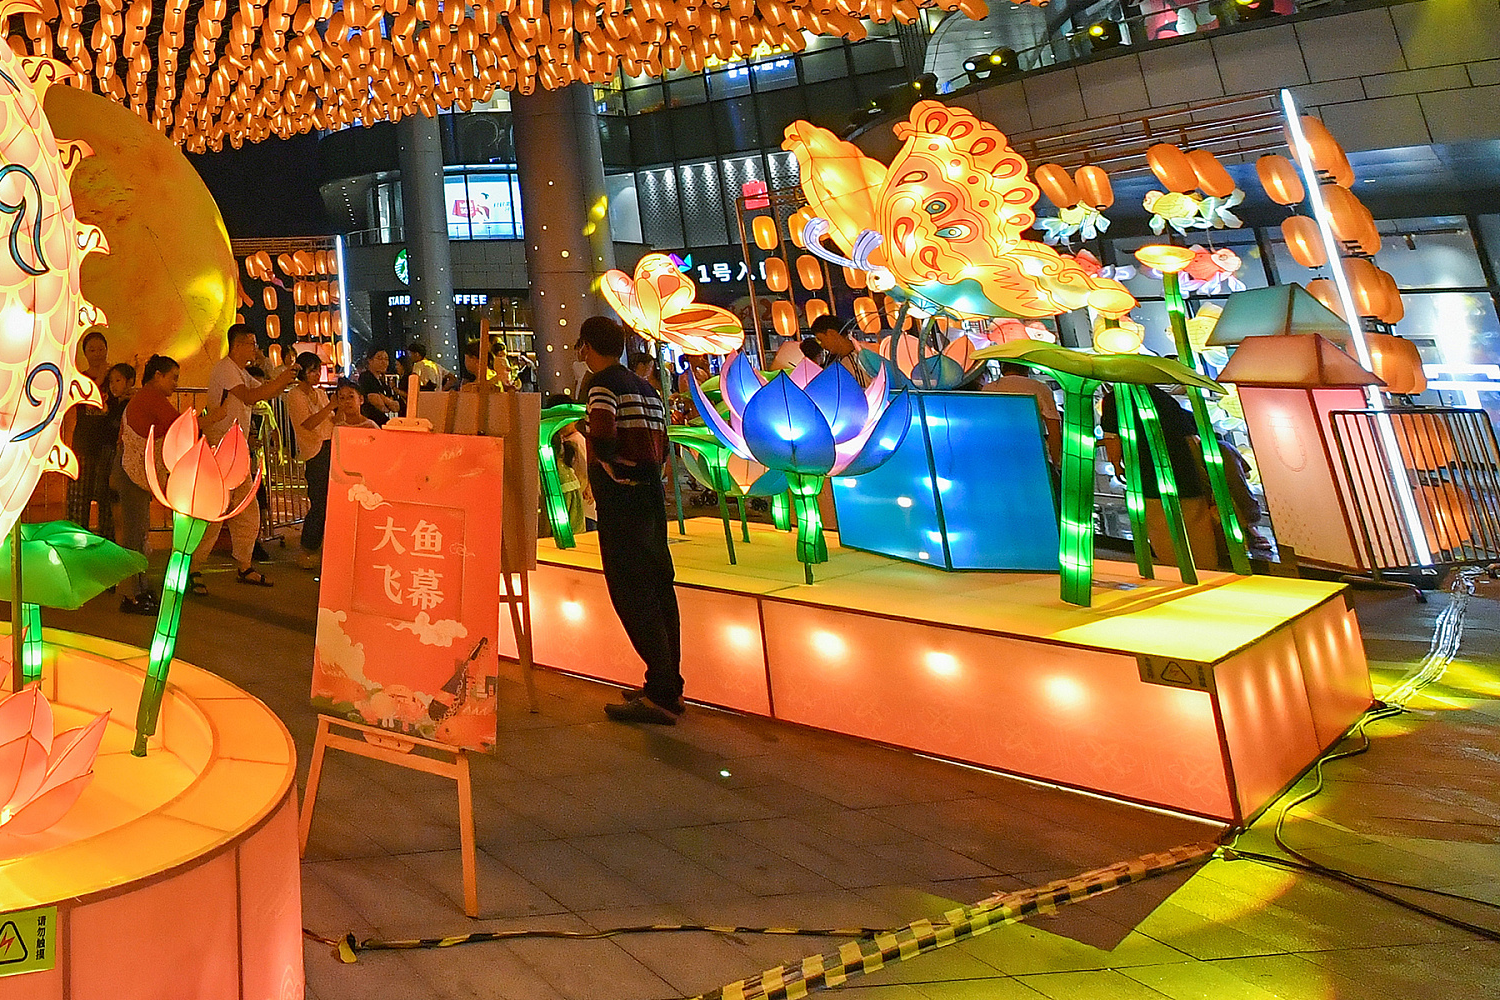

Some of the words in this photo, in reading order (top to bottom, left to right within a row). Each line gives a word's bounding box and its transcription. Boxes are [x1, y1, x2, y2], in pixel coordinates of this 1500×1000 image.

[372, 516, 445, 560] 大鱼
[372, 564, 445, 610] 飞幕
[36, 916, 46, 960] 请勿触摸
